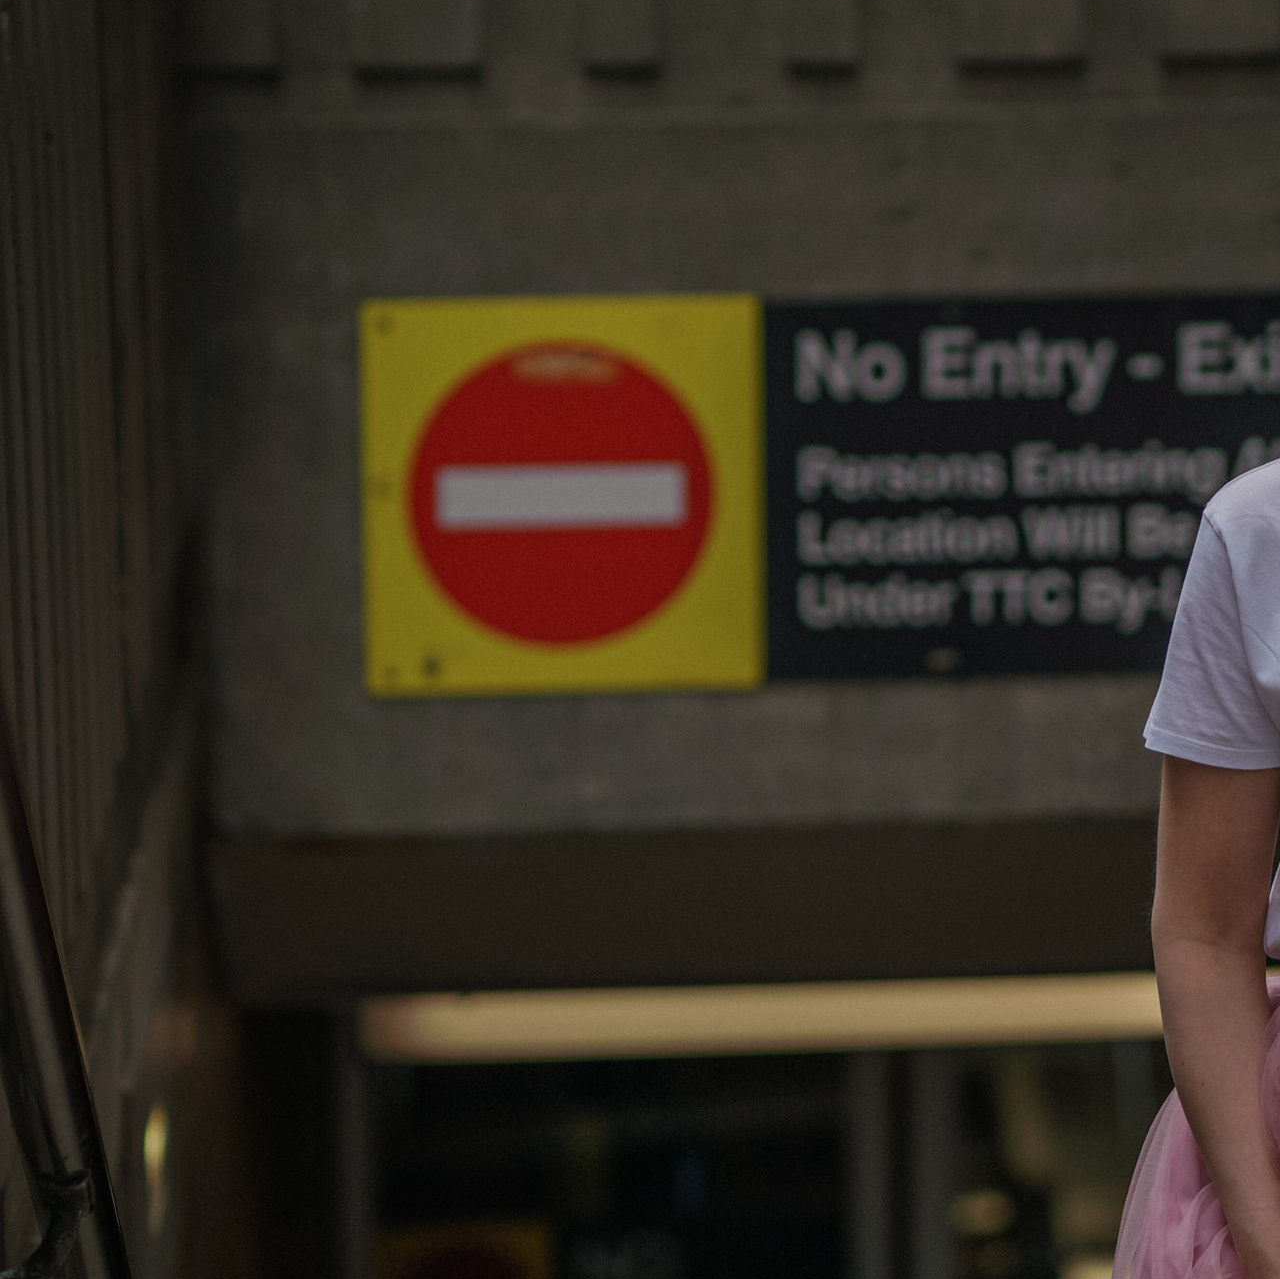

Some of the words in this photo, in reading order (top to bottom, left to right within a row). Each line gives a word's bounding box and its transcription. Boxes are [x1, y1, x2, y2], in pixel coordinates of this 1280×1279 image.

[796, 328, 906, 403] No
[921, 324, 1117, 413] Entry
[798, 446, 1006, 502] Persons
[1013, 440, 1226, 505] Entering
[798, 509, 1020, 565] Location
[1021, 504, 1121, 561] Will
[798, 570, 957, 629] Under
[963, 569, 1073, 626] TTC
